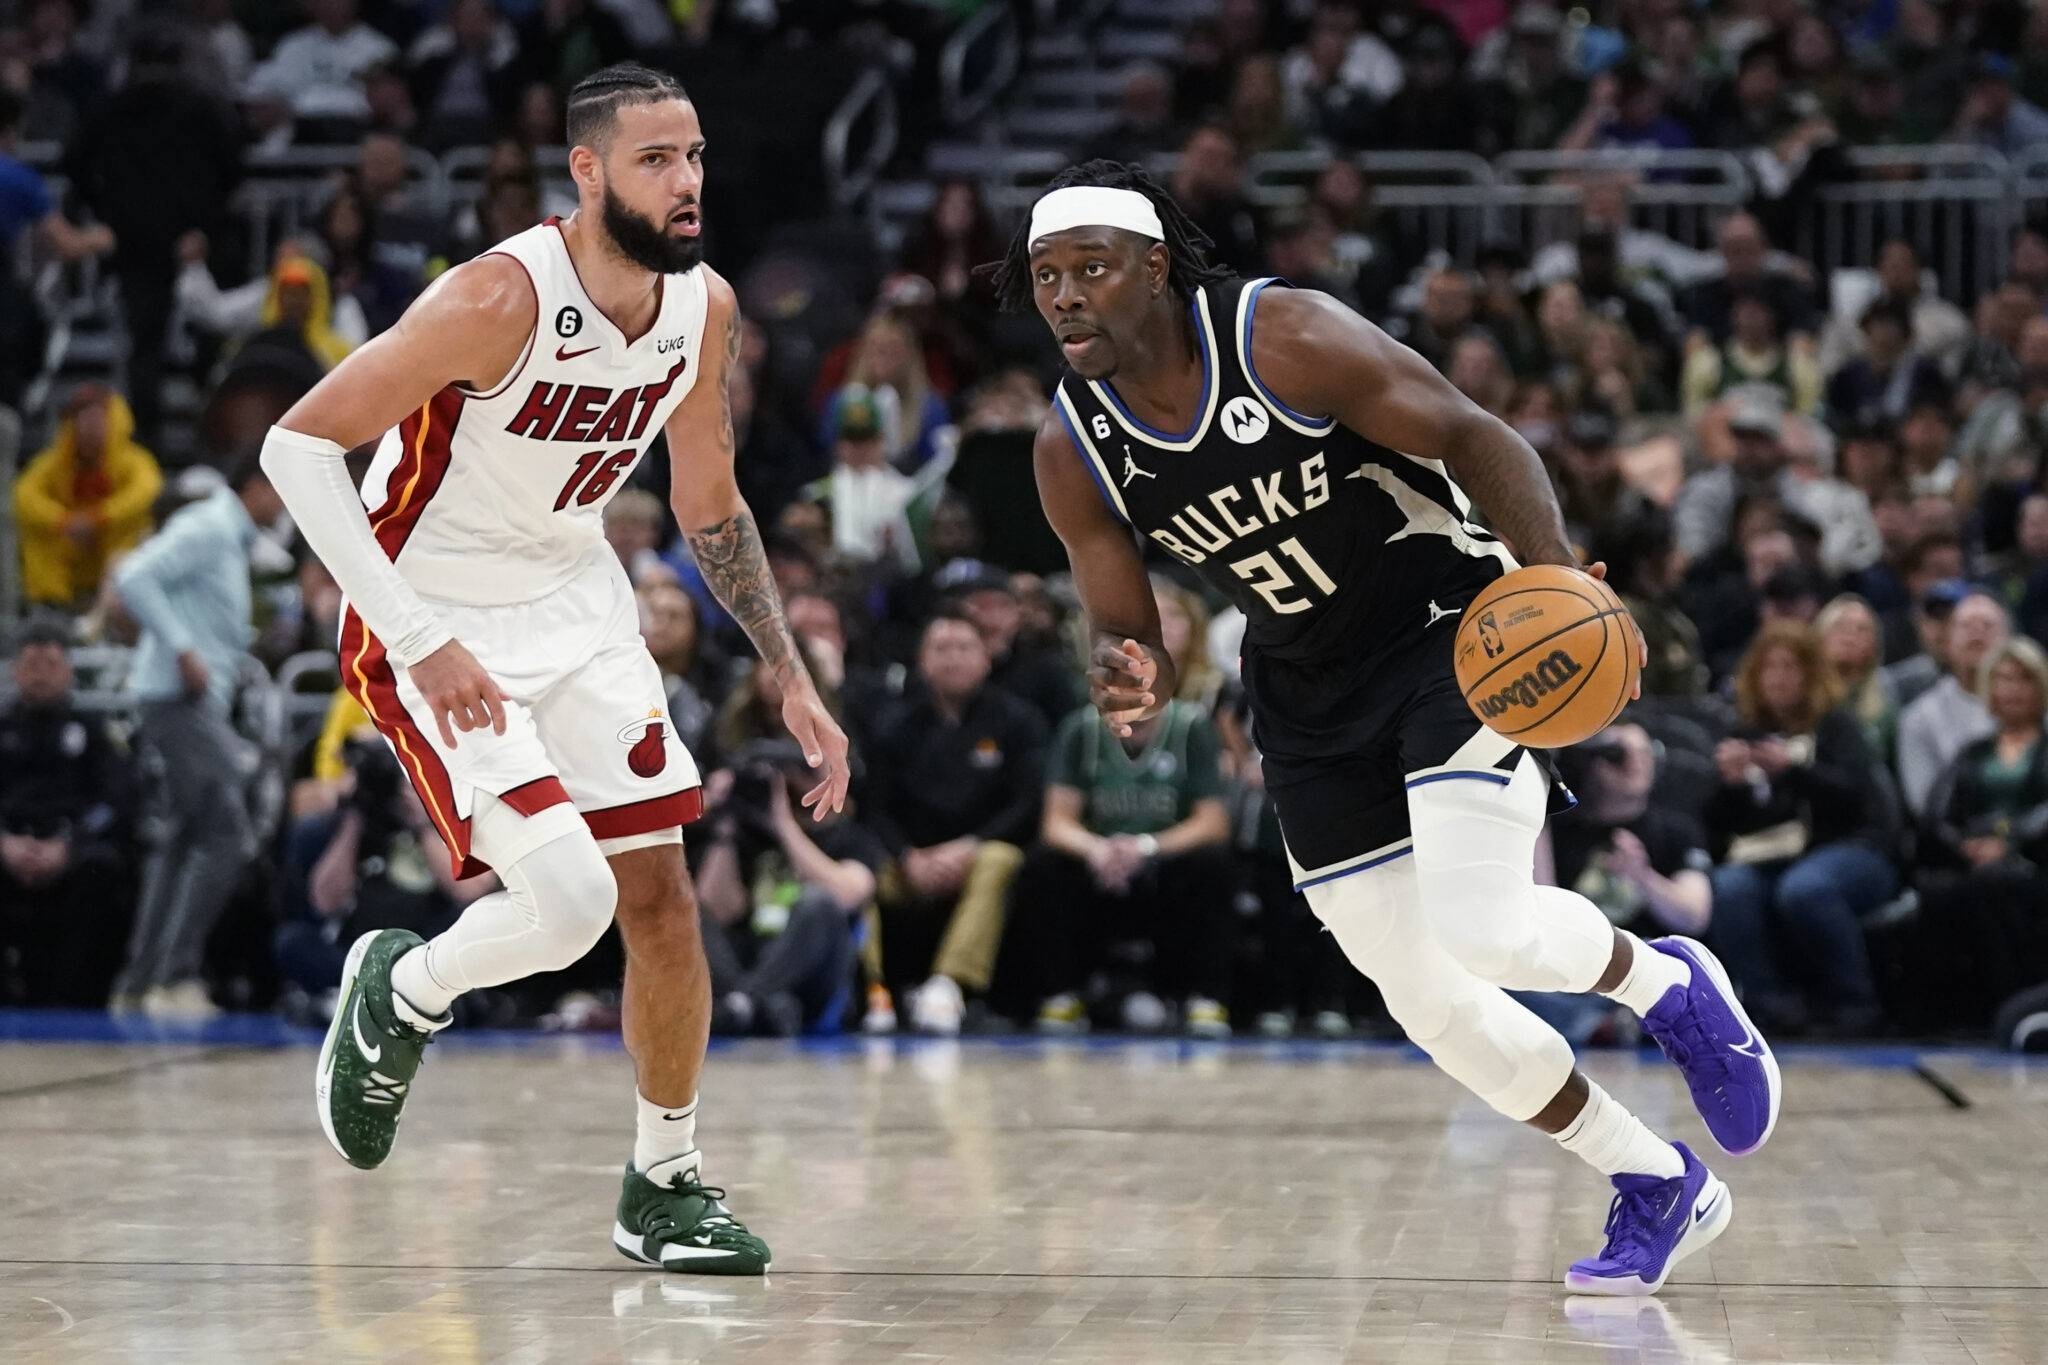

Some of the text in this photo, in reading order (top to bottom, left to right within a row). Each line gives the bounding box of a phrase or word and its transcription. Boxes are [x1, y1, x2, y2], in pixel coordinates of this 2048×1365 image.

[560, 310, 577, 335] 6
[657, 336, 685, 354] UKG
[504, 355, 686, 442] HEAT
[1091, 413, 1112, 440] 6
[552, 448, 638, 513] 16
[1149, 450, 1331, 564] BUCKS
[1229, 536, 1338, 615] 21
[1475, 649, 1584, 719] Wilson
